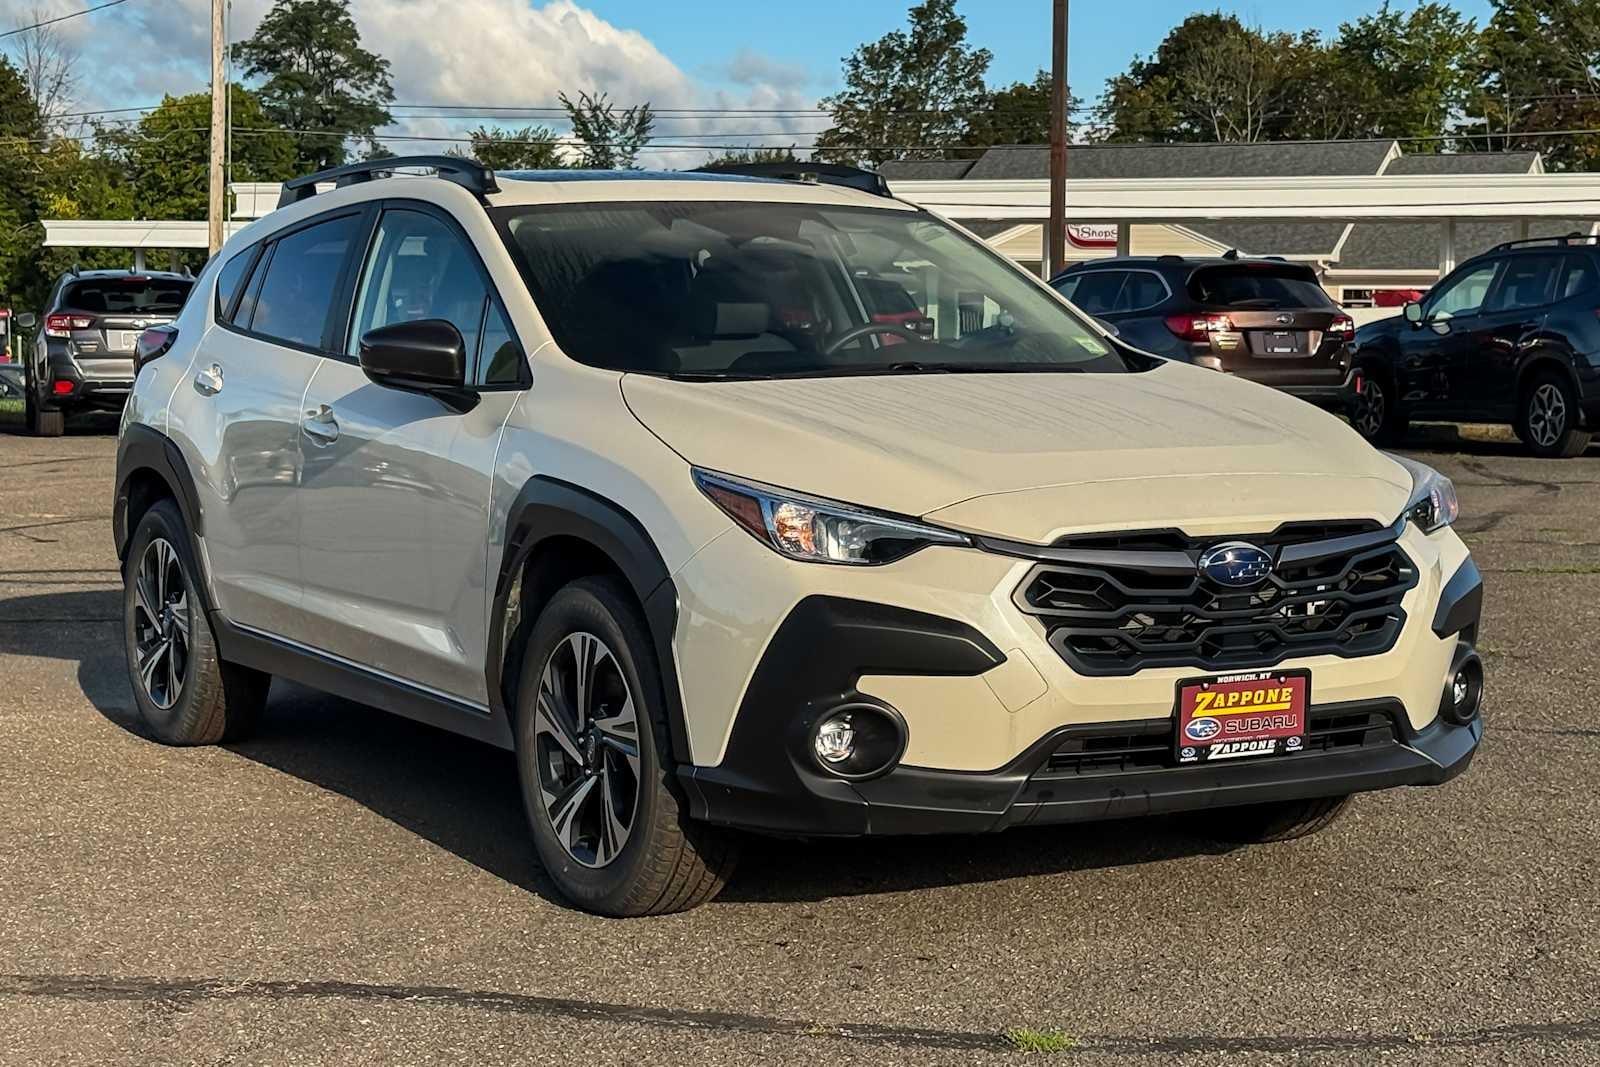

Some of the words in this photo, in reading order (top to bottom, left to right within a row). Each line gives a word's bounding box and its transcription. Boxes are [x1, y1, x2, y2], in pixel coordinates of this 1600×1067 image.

[1192, 688, 1293, 717] ZAPPONE
[1225, 715, 1297, 733] SUBARU
[1207, 740, 1276, 760] ZAPPONE
